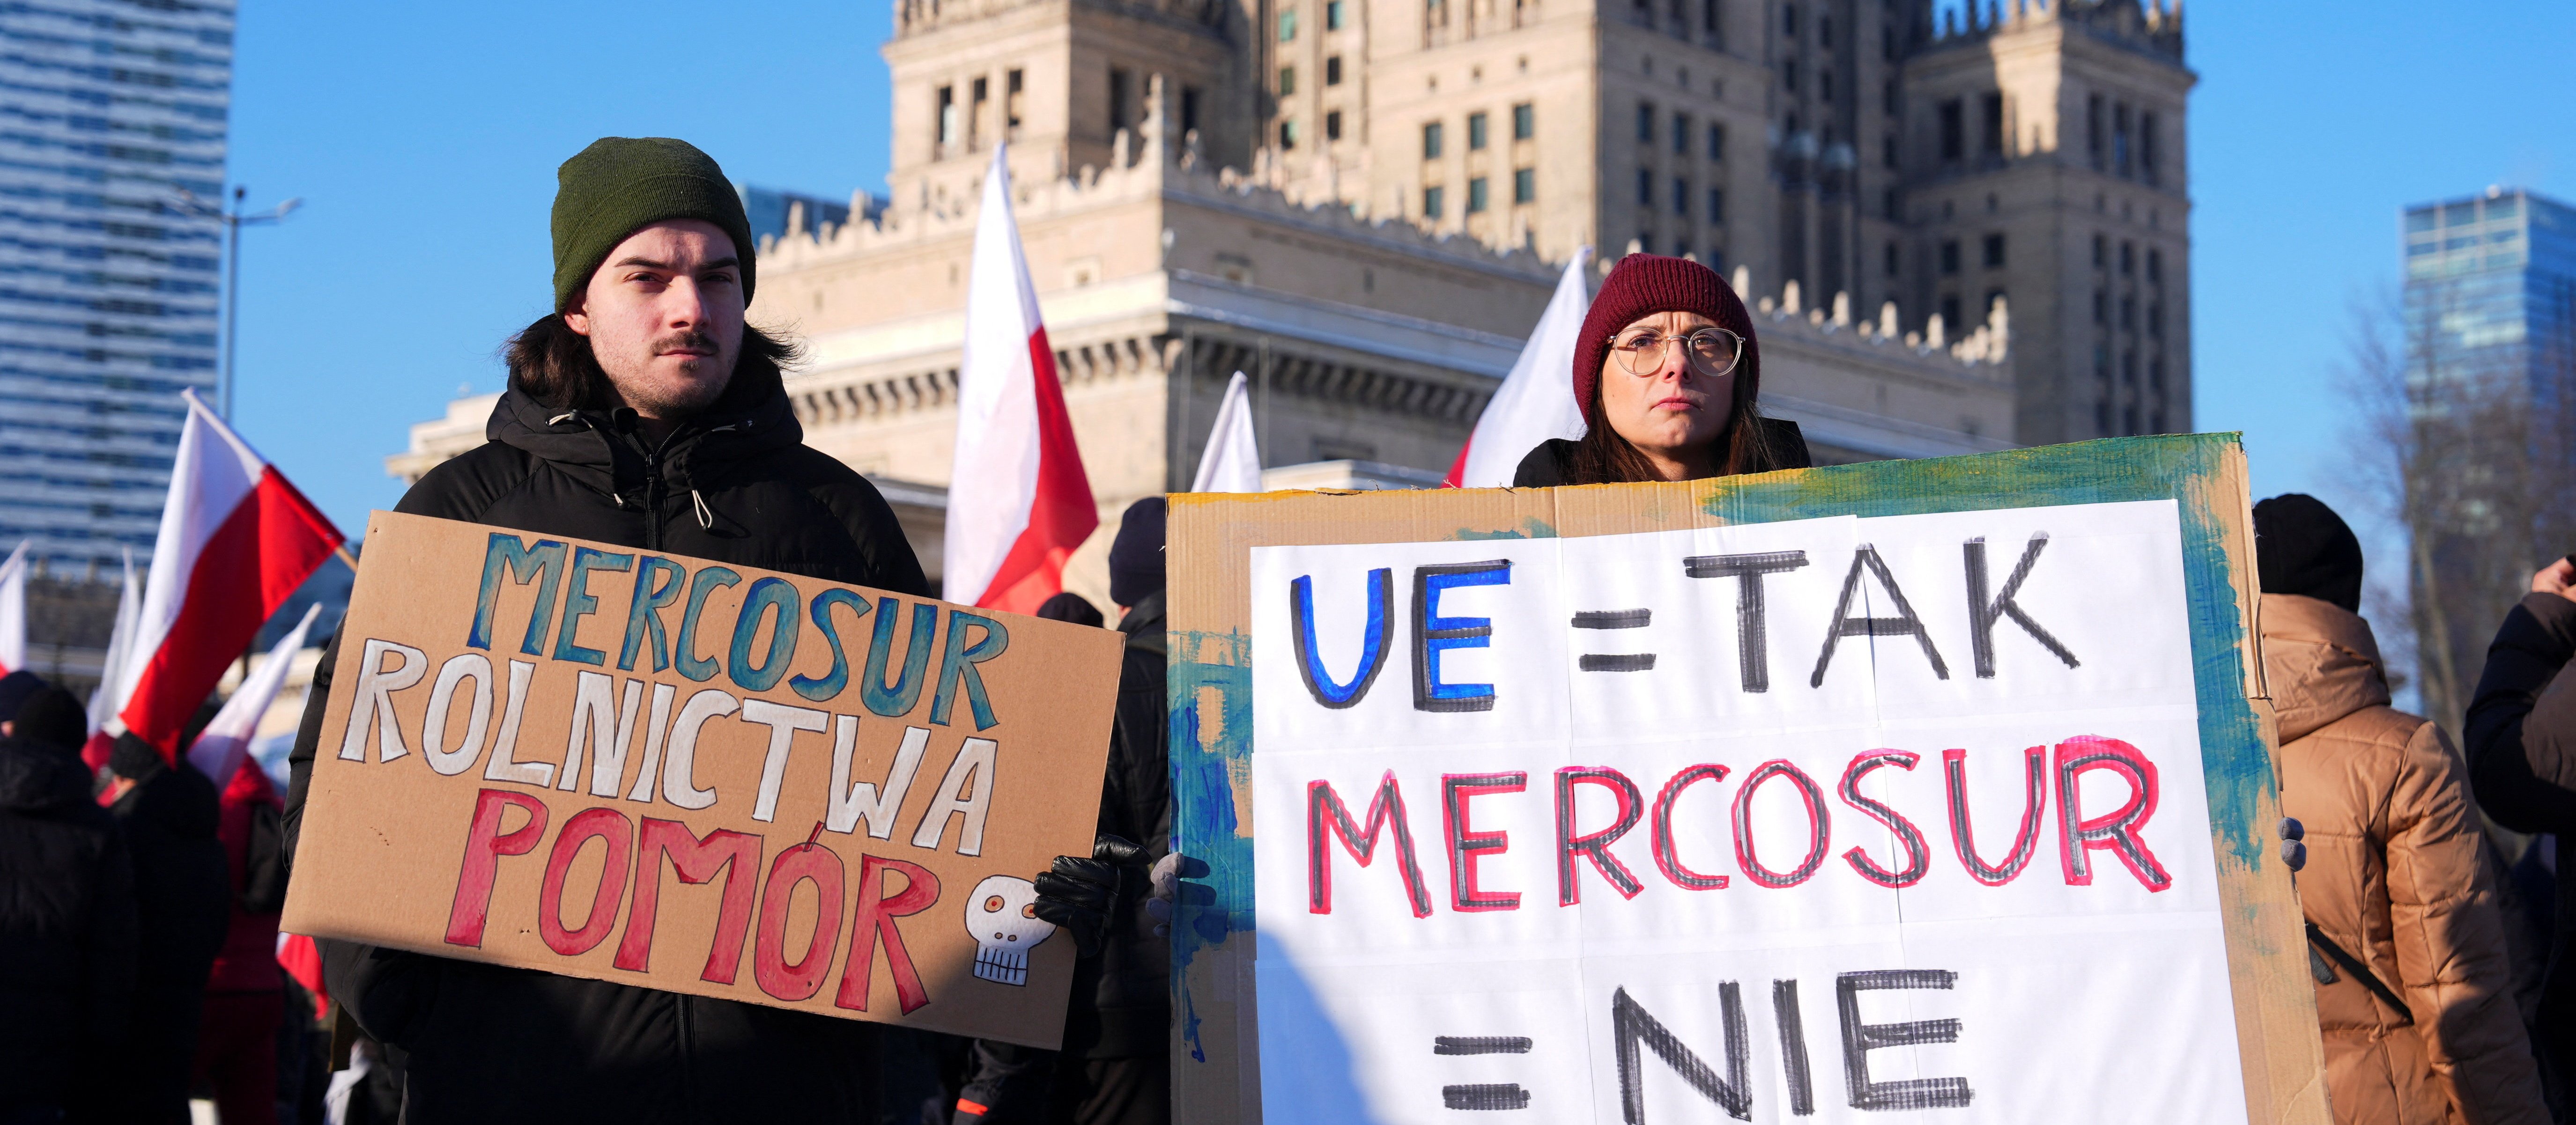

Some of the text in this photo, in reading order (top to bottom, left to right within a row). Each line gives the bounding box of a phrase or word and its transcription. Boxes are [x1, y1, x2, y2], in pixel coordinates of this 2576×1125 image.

[467, 532, 1008, 730] MERCOSUR
[1290, 532, 2079, 711] UE = TAK
[339, 638, 999, 856] ROLNICTWA
[1308, 735, 2171, 918] MERCOSUR
[445, 789, 940, 1016] POMÓR
[1433, 969, 1975, 1125] = NIE
